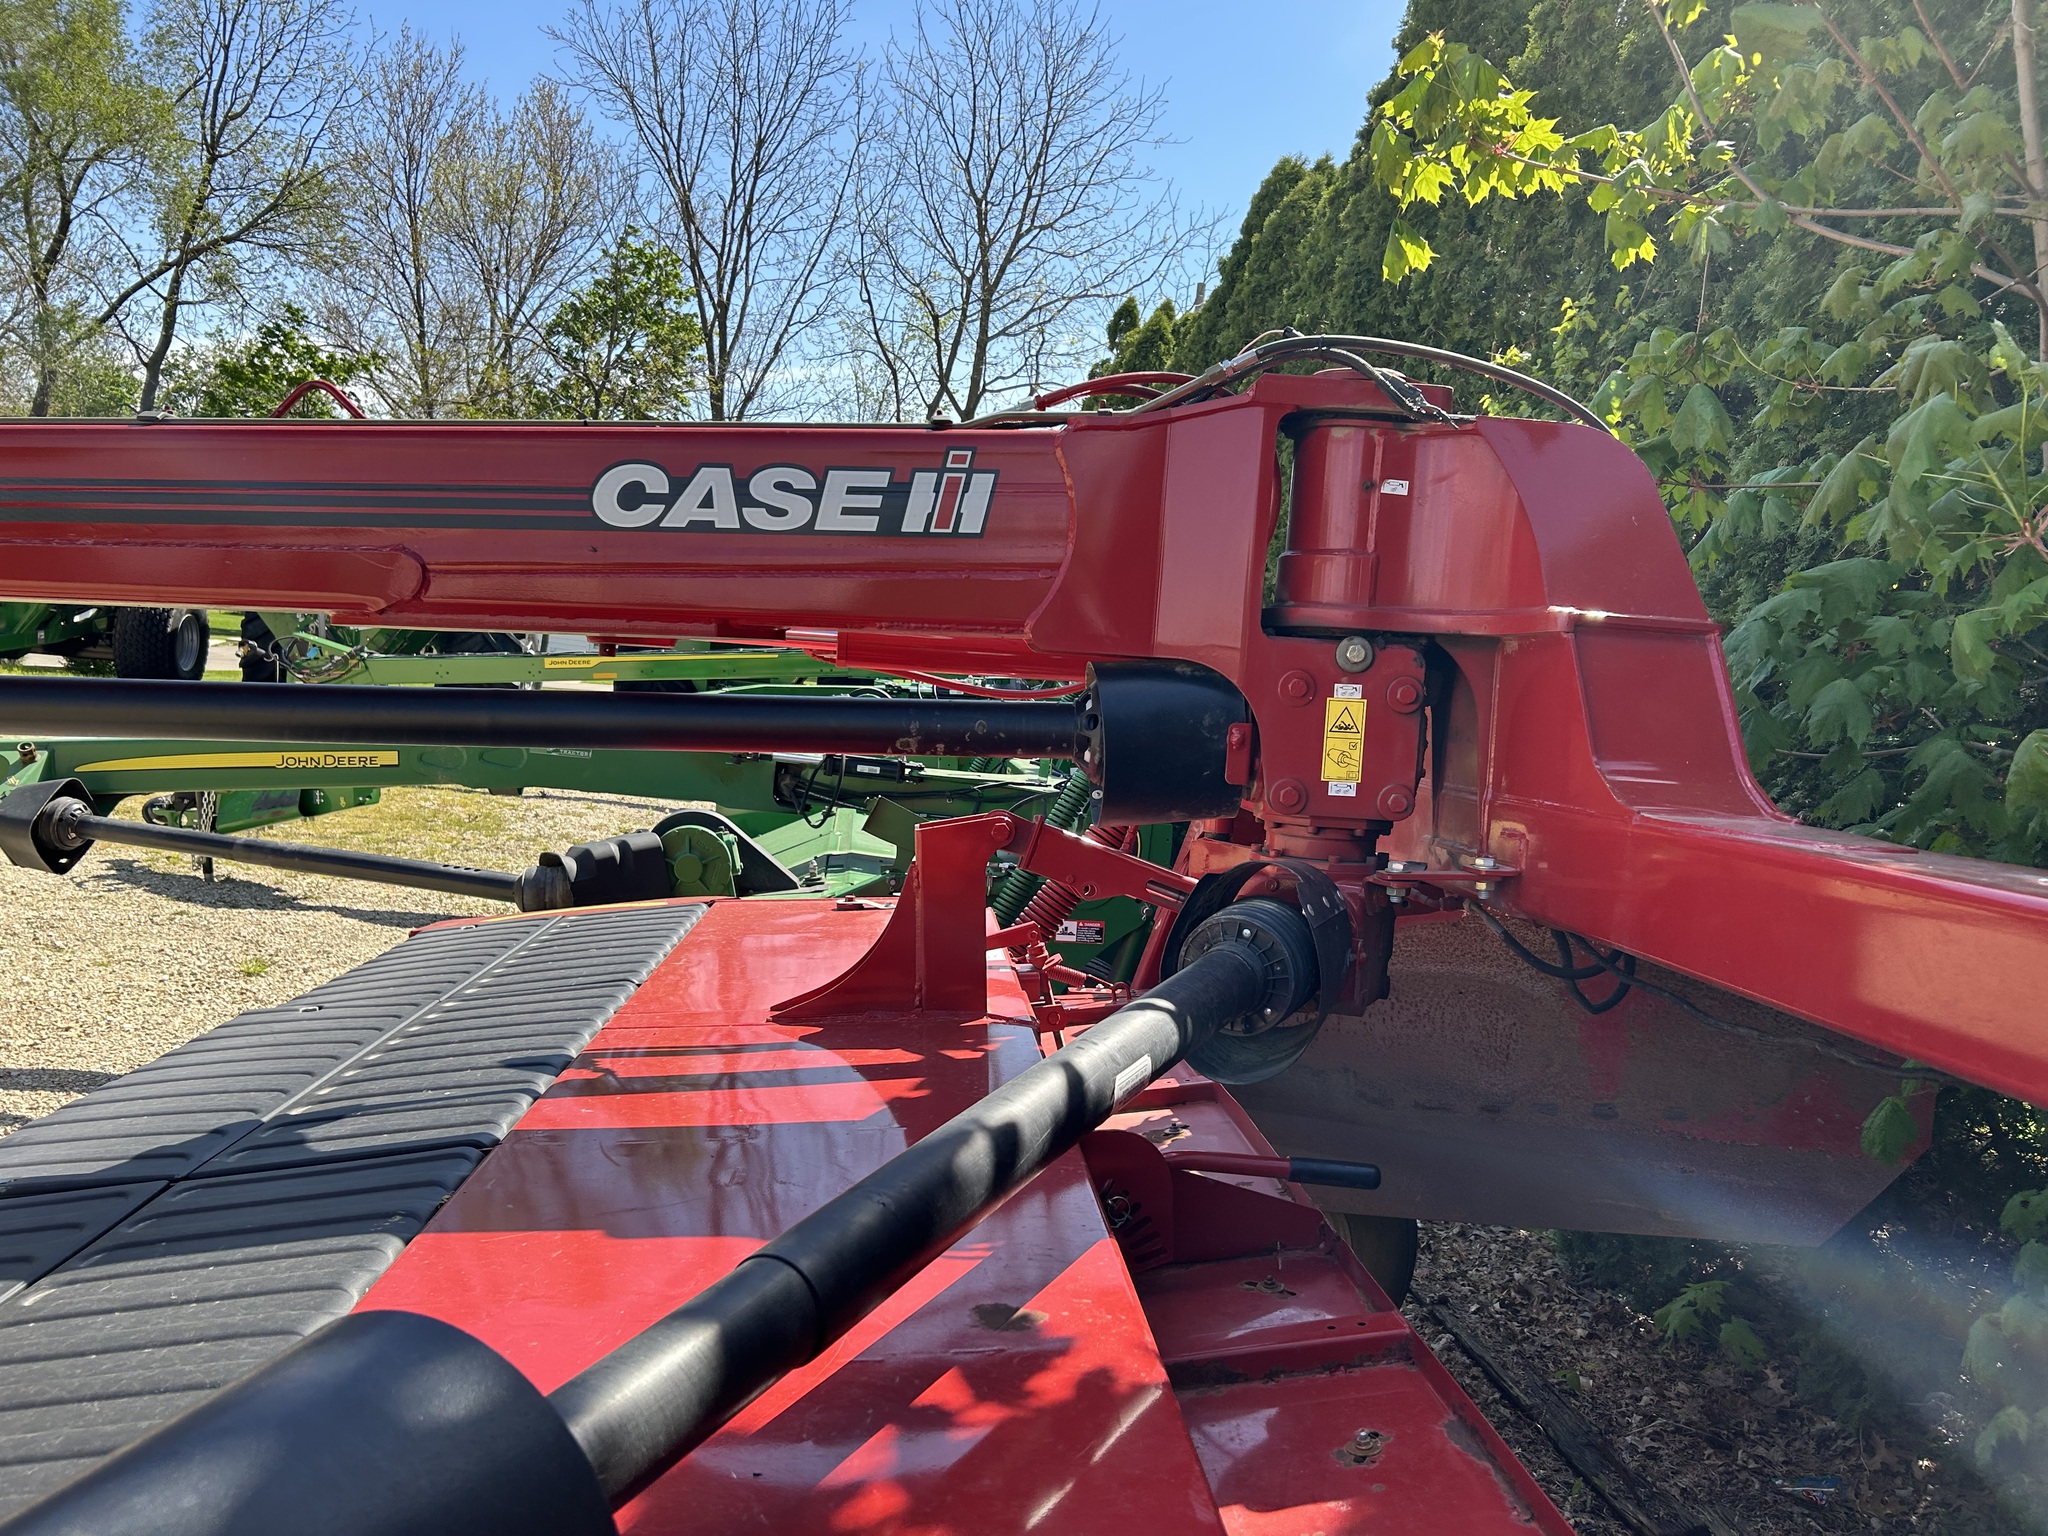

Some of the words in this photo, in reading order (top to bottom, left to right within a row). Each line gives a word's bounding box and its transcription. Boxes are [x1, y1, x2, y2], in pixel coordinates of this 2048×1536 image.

[592, 463, 891, 531] CASE
[276, 754, 321, 767] JOHN
[323, 754, 379, 766] DEERE
